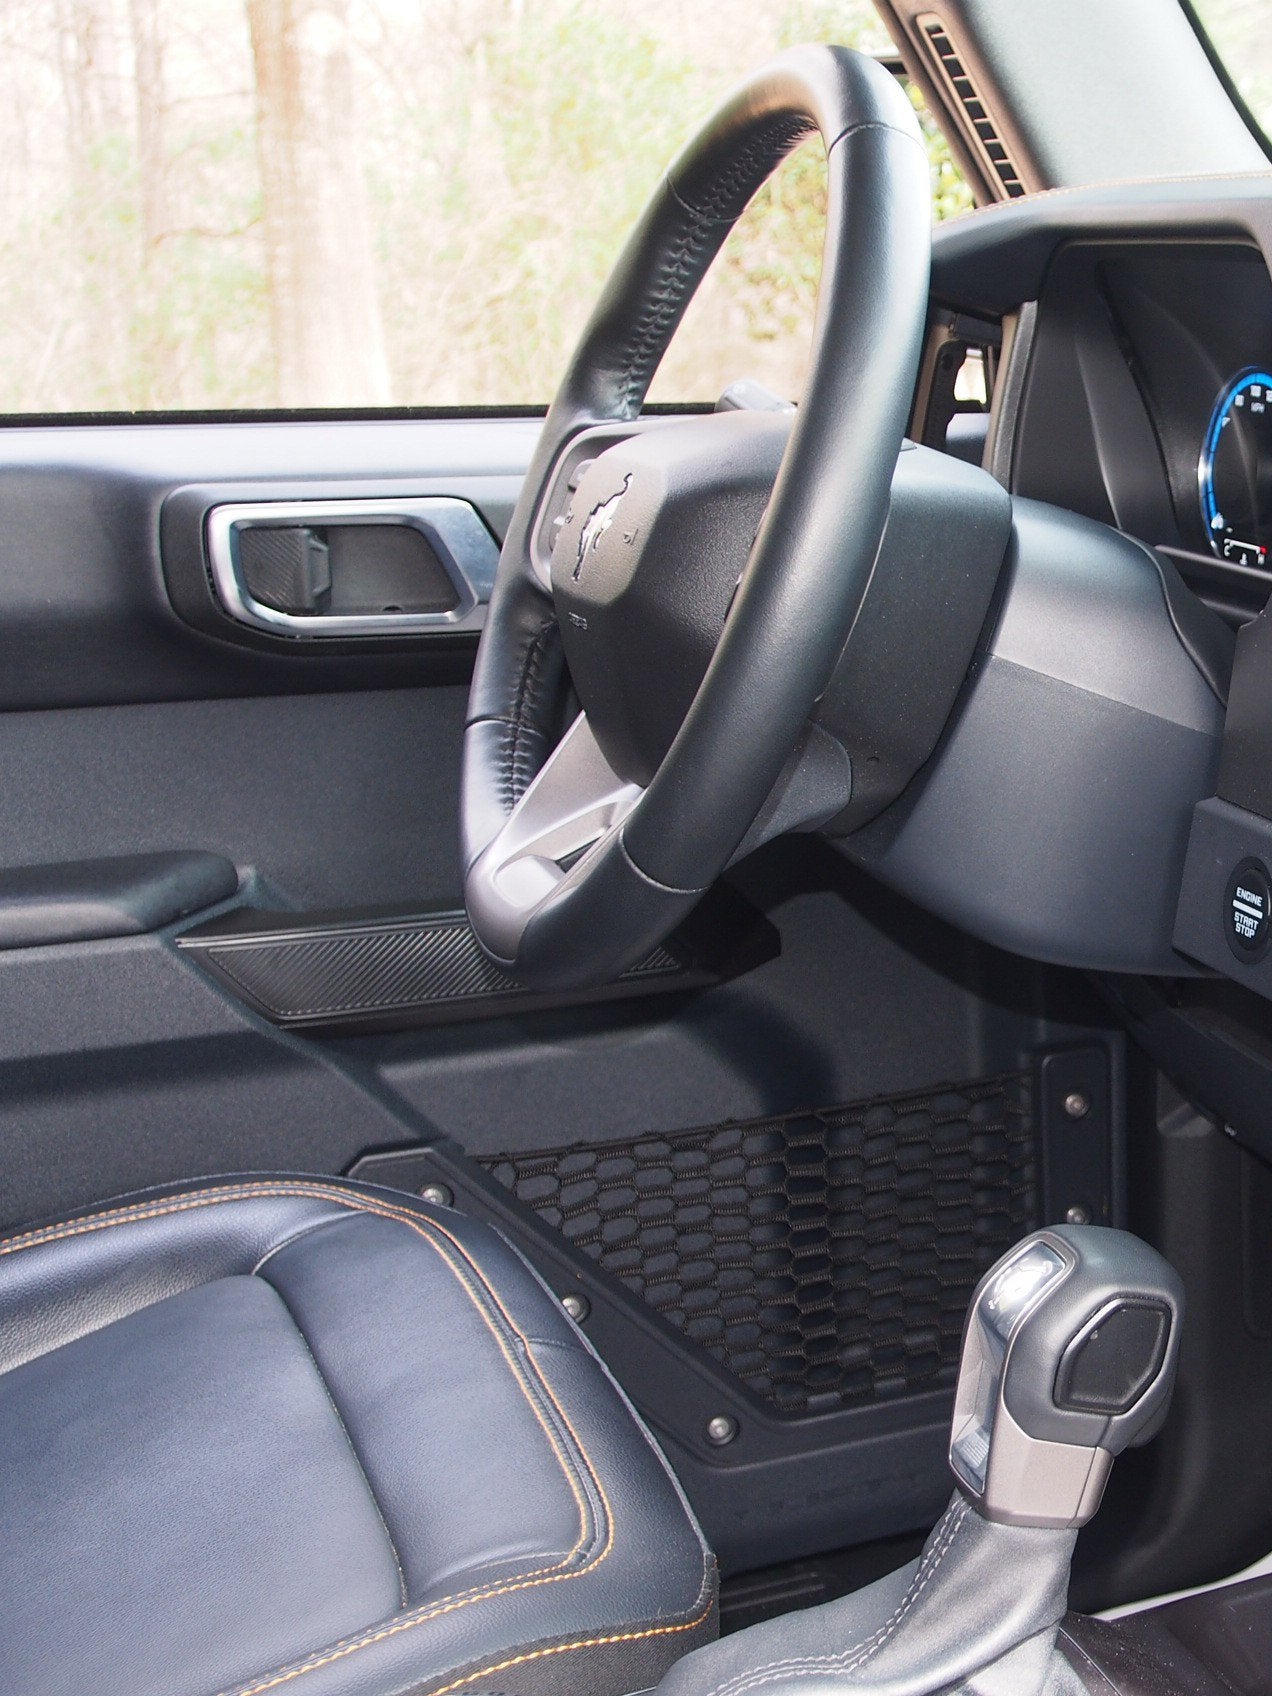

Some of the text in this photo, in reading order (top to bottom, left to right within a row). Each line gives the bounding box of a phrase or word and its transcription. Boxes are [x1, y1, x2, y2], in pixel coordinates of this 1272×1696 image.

[1236, 886, 1263, 907] ENGINE
[1234, 910, 1259, 931] START
[1235, 922, 1255, 939] STOP
